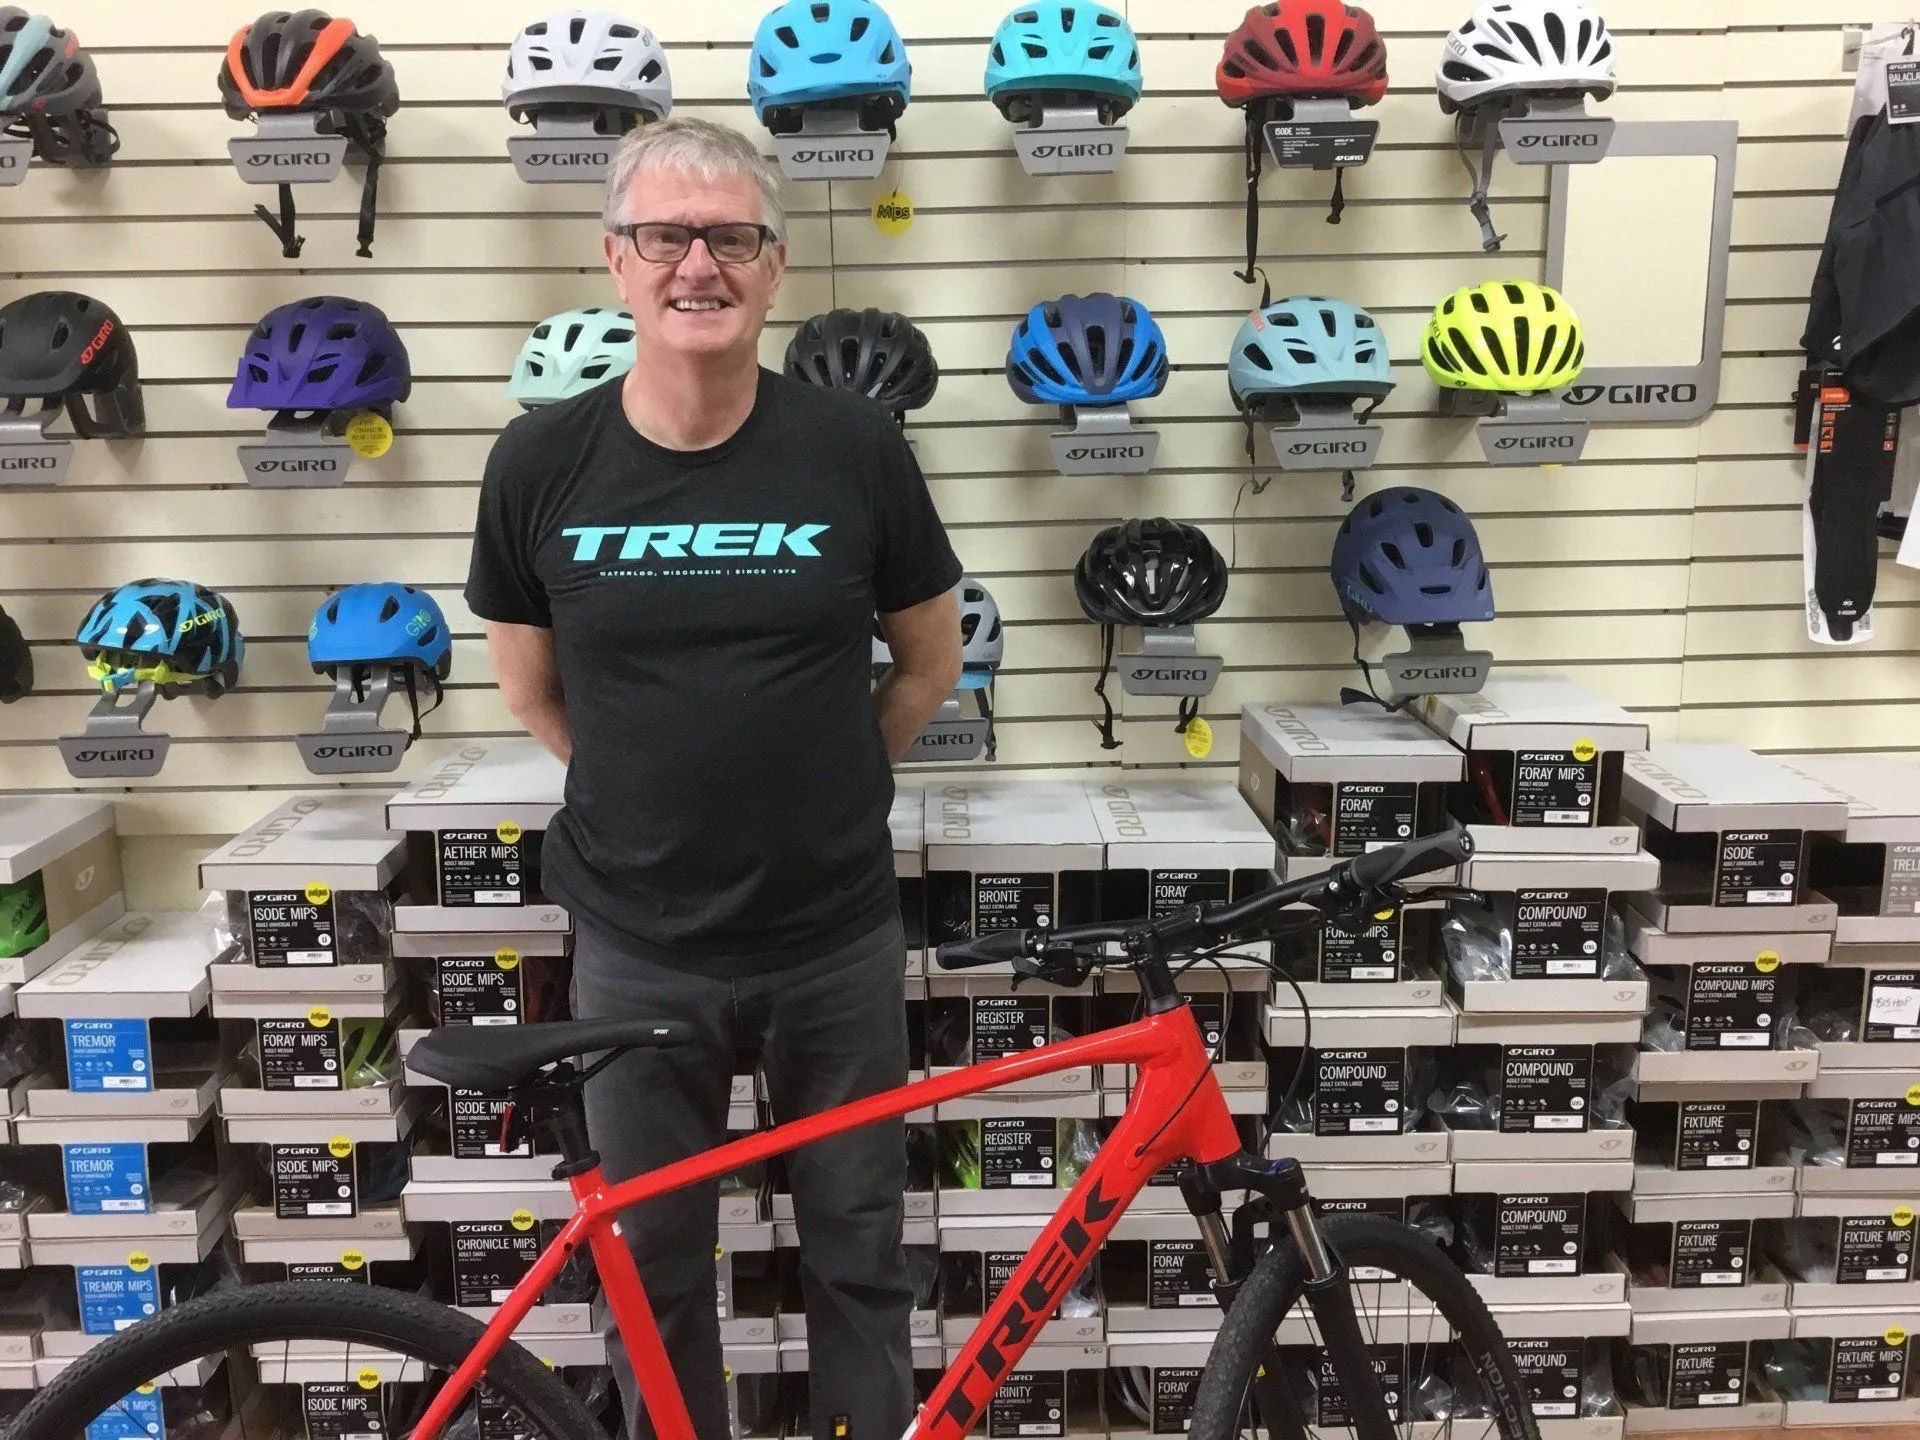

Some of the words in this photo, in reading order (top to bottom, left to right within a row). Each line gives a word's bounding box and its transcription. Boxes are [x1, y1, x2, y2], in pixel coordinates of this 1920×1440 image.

[1448, 35, 1468, 56] GIRO
[1274, 127, 1293, 136] ISODE
[1542, 133, 1598, 148] GIRO
[817, 148, 874, 163] GIRO
[1058, 143, 1113, 157] GIRO
[273, 151, 331, 167] GIRO
[552, 152, 609, 167] GIRO
[94, 319, 114, 351] GIRO
[1608, 383, 1698, 405] GIRO
[1312, 440, 1367, 455] GIRO
[1520, 435, 1575, 449] GIRO
[1090, 445, 1145, 460] GIRO
[1, 456, 57, 470] GIRO
[280, 458, 337, 473] GIRO
[561, 523, 832, 561] TREK
[196, 608, 227, 626] GIRO
[405, 608, 432, 637] GIRO
[1153, 668, 1208, 681] GIRO
[1424, 666, 1477, 679] GIRO
[921, 734, 974, 747] GIRO
[1275, 719, 1331, 751] GIRO
[100, 748, 155, 763] GIRO
[338, 744, 393, 758] GIRO
[1519, 766, 1554, 780] FORAY
[1558, 767, 1585, 780] MIPS
[1340, 798, 1374, 811] FORAY
[943, 801, 971, 839] GIRO
[1107, 800, 1147, 837] GIRO
[230, 816, 301, 857] GIRO
[443, 846, 487, 859] AETHER
[491, 846, 519, 859] MIPS
[1723, 846, 1756, 860] ISODE
[1169, 872, 1198, 880] GIRO
[979, 890, 1021, 903] BRONTE
[1155, 885, 1188, 898] FORAY
[254, 907, 287, 921] ISODE
[290, 907, 318, 920] MIPS
[1518, 906, 1587, 920] COMPOUND
[1325, 926, 1356, 938] FOR
[1712, 965, 1744, 973] GIRO
[442, 973, 474, 986] ISODE
[478, 973, 505, 985] MIPS
[1694, 980, 1749, 991] COMPOUND
[1750, 979, 1775, 991] MIPS
[976, 1011, 1025, 1024] REGISTER
[84, 1022, 113, 1030] GIRO
[71, 1035, 116, 1047] TREMOR
[263, 1034, 296, 1047] FORAY
[301, 1034, 328, 1047] MIPS
[1336, 1051, 1367, 1059] GIRO
[1523, 1048, 1555, 1056] GIRO
[1319, 1065, 1387, 1080] COMPOUND
[1506, 1062, 1574, 1076] COMPOUND
[455, 1101, 487, 1114] ISODE
[1683, 1116, 1725, 1128] FIXTURE
[1854, 1113, 1895, 1125] FIXTURE
[1898, 1113, 1920, 1125] MIPS
[984, 1132, 1032, 1145] REGISTER
[69, 1160, 114, 1172] TREMOR
[277, 1160, 308, 1173] ISODE
[312, 1160, 339, 1172] MIPS
[1336, 1202, 1367, 1210] GIRO
[1517, 1196, 1549, 1204] GIRO
[1501, 1209, 1567, 1223] COMPOUND
[471, 1224, 503, 1232] GIRO
[1678, 1235, 1719, 1247] FIXTURE
[1844, 1231, 1884, 1243] FIXTURE
[1887, 1229, 1912, 1242] MIPS
[456, 1238, 510, 1250] CHRONICLE
[513, 1237, 537, 1249] MIPS
[1153, 1255, 1185, 1267] FORAY
[988, 1266, 1018, 1278] TRINI
[82, 1281, 125, 1293] TREMOR
[127, 1280, 153, 1291] MIPS
[930, 1175, 1121, 1430] TREK
[1512, 1353, 1567, 1367] MPOUND
[1837, 1351, 1876, 1363] FIXTURE
[1879, 1350, 1903, 1362] MIPS
[1676, 1357, 1716, 1370] FIXTURE
[1158, 1381, 1190, 1394] FORAY
[132, 1400, 157, 1411] MIPS
[307, 1398, 338, 1411] ISODE
[341, 1398, 367, 1411] MIPS
